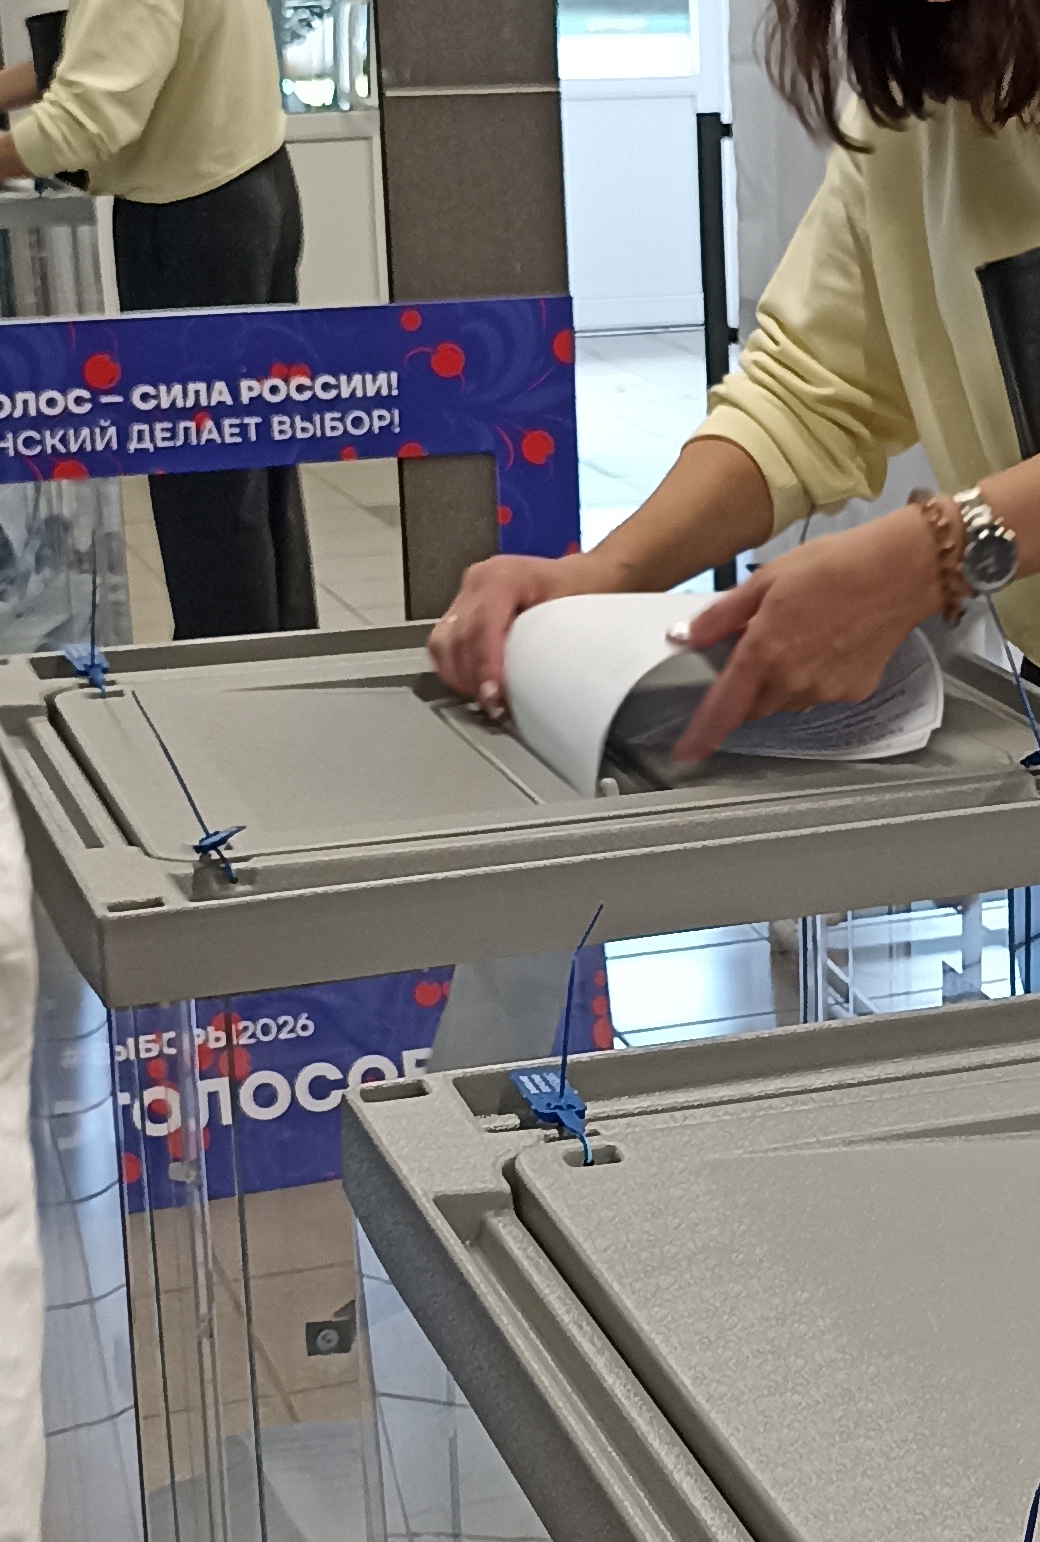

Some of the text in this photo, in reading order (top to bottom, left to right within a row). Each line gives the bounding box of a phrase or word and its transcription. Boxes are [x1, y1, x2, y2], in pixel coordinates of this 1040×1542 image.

[131, 380, 233, 412] СИЛА
[240, 371, 399, 405] РОССИИ!
[127, 416, 263, 454] ДЕЛАЕТ
[270, 408, 401, 441] ВЫБОР!
